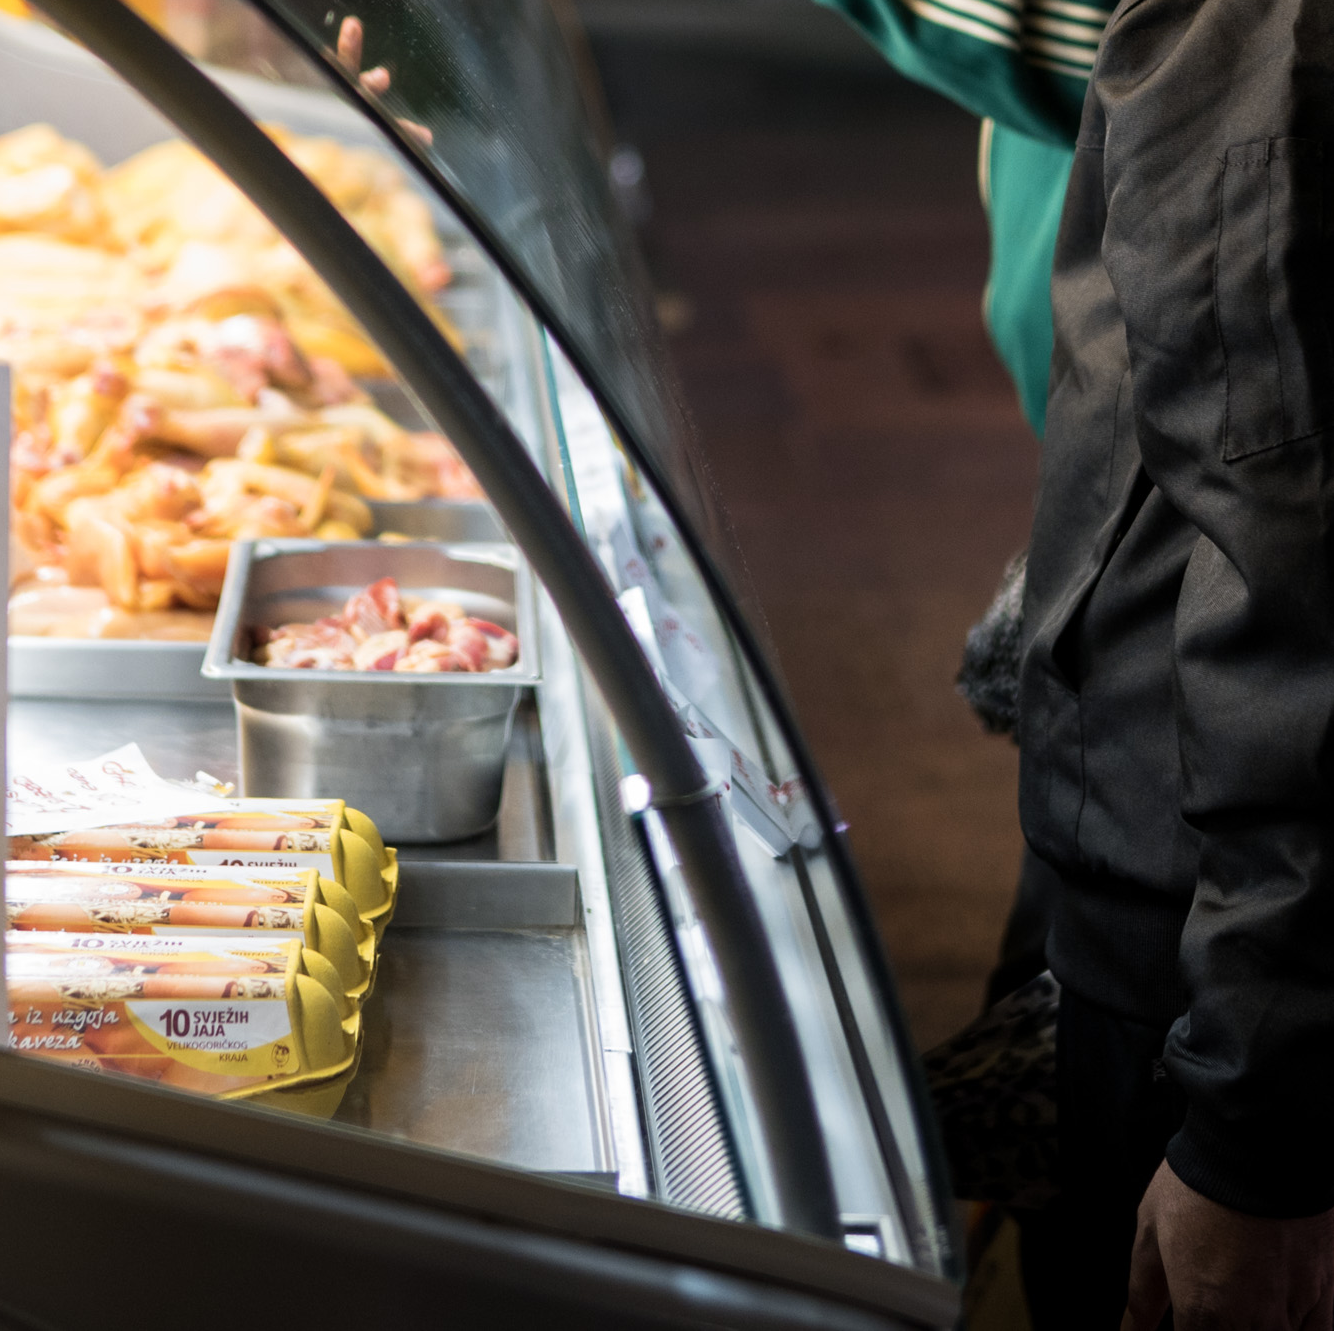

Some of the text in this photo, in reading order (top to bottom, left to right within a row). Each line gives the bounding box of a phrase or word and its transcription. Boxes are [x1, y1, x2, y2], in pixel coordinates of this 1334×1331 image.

[25, 1006, 43, 1024] iz
[51, 1006, 120, 1031] uzgoja
[159, 1007, 250, 1037] 10 SVJEŽIH
[192, 1024, 226, 1037] JAJA
[7, 1031, 82, 1049] kaveza
[167, 1039, 249, 1050] VELIKOGORIČKOG
[219, 1053, 249, 1062] KRAJA
